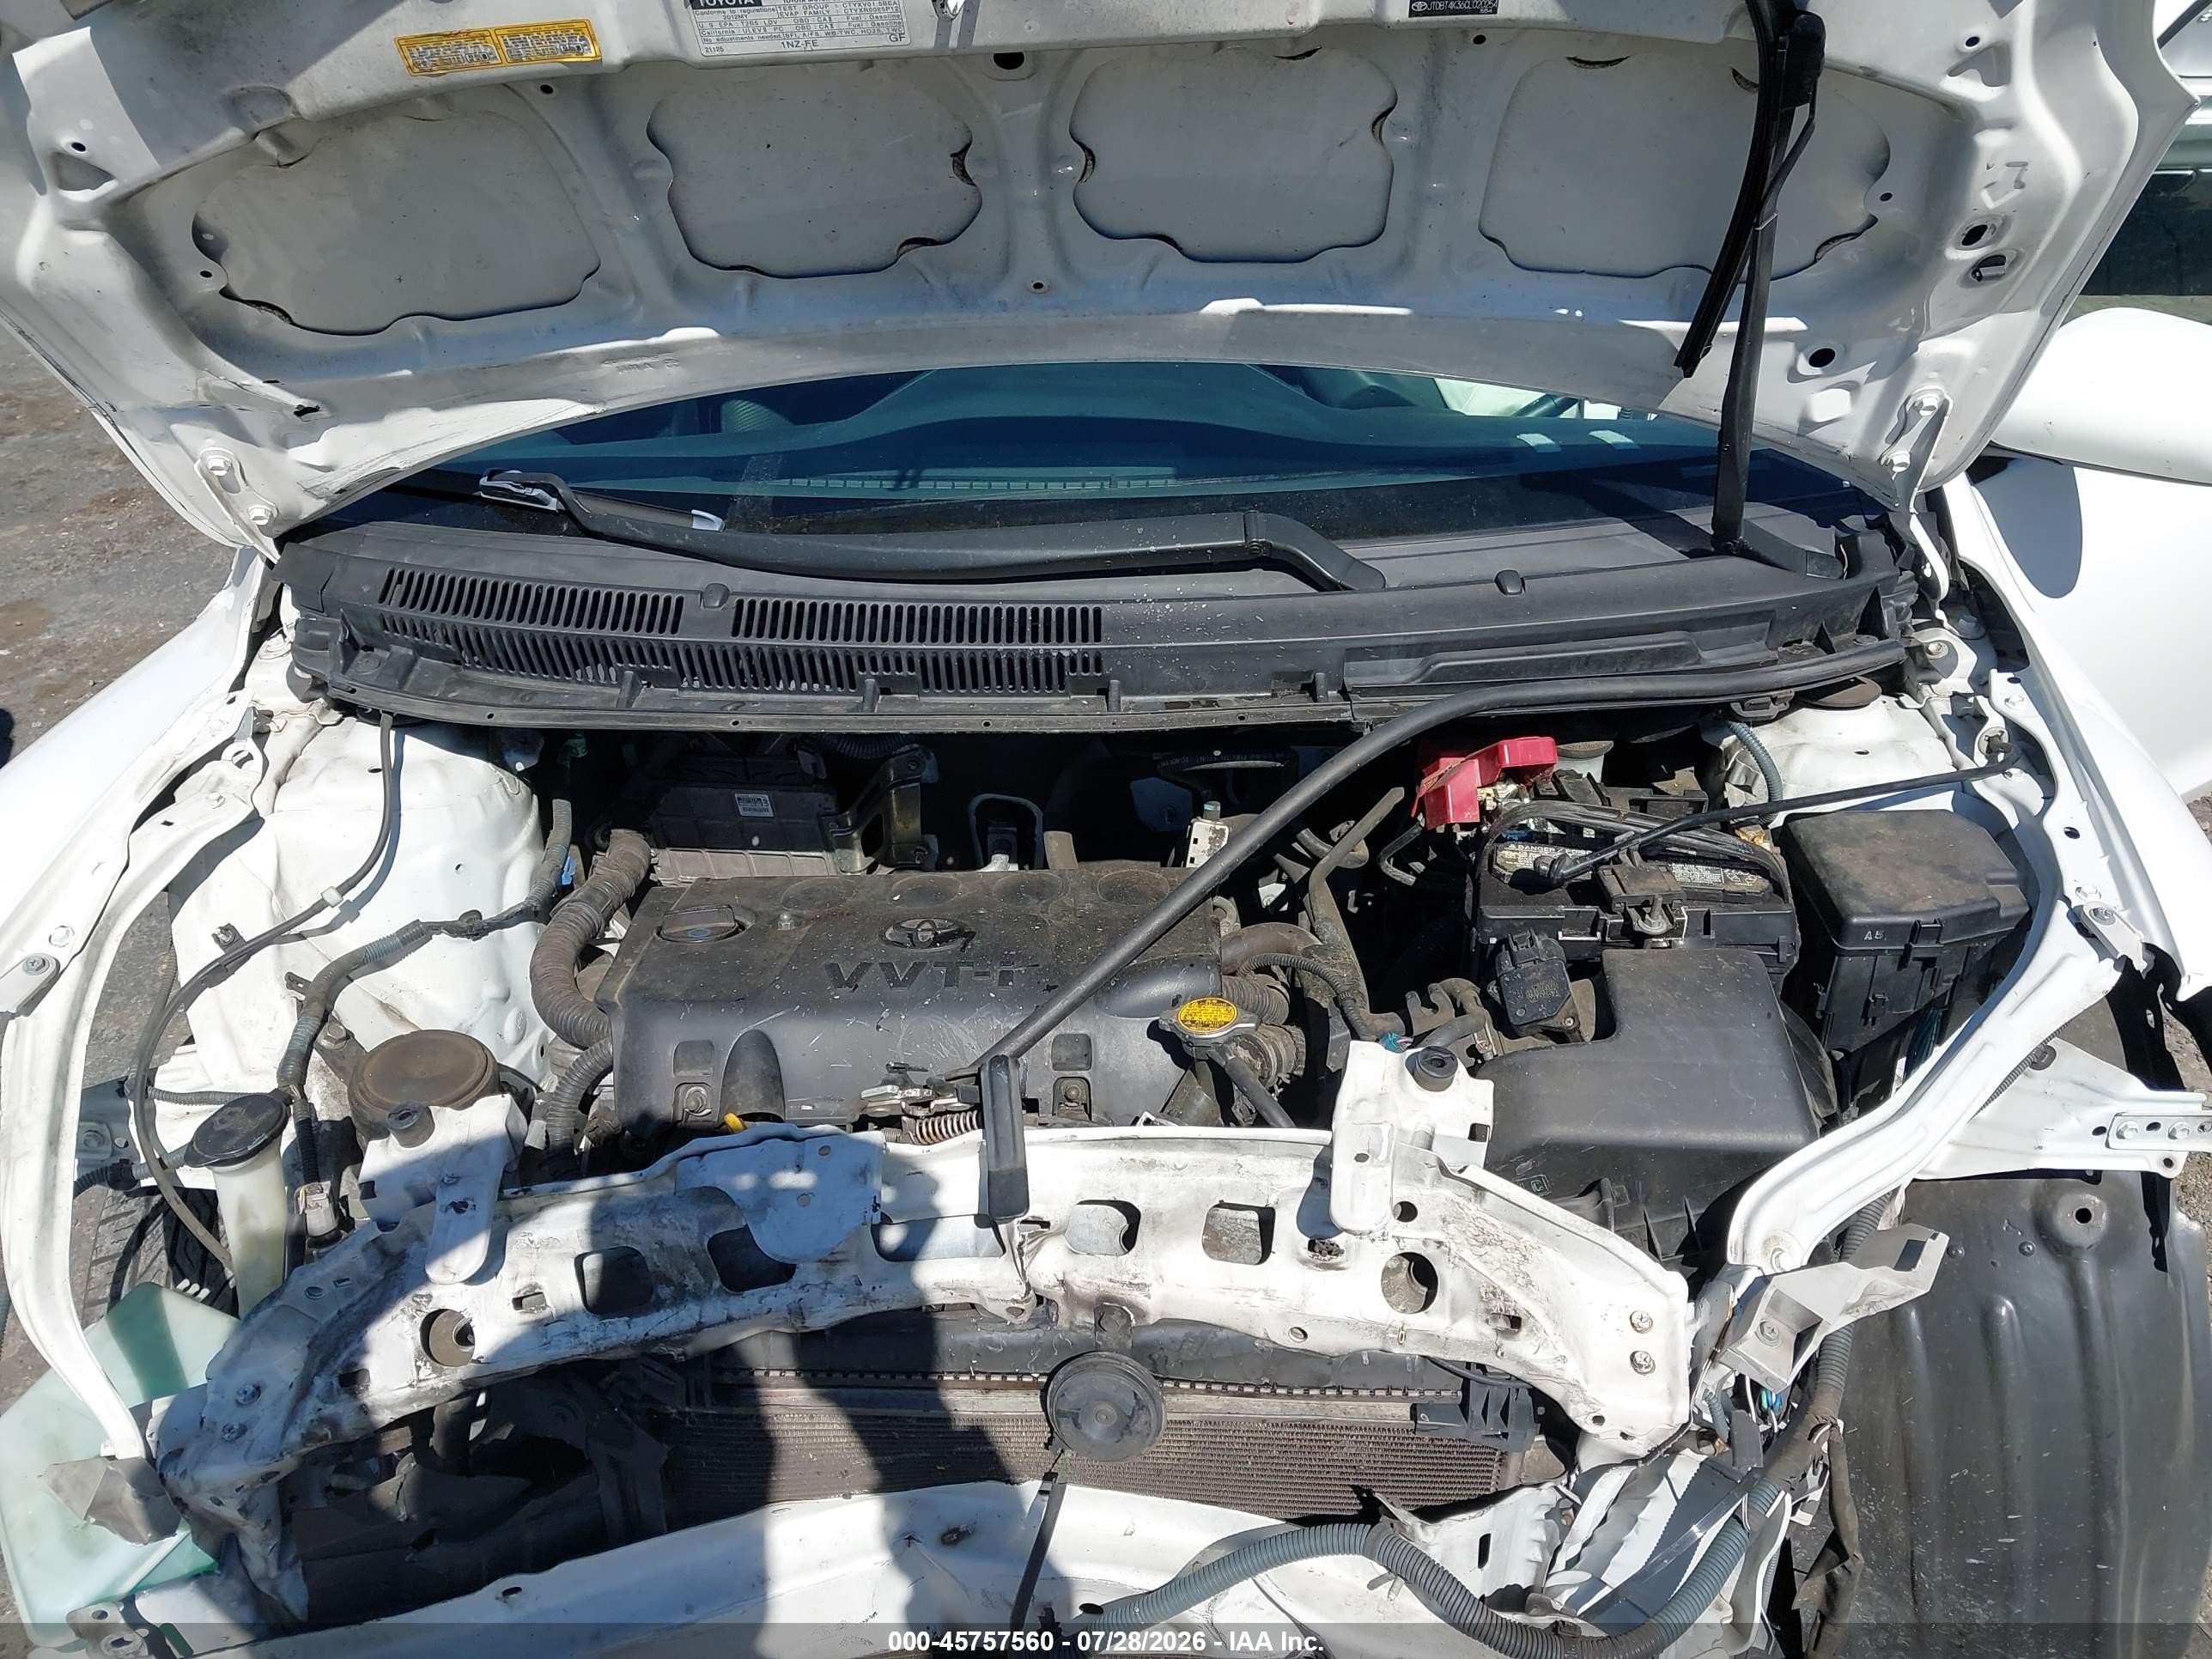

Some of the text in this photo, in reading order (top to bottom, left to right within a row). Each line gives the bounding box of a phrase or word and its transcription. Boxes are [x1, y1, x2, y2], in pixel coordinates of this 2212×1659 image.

[889, 33, 906, 42] GF
[781, 38, 819, 49] 1NZ-FE
[1517, 844, 1556, 853] DANGER
[823, 960, 1016, 990] VVT-i
